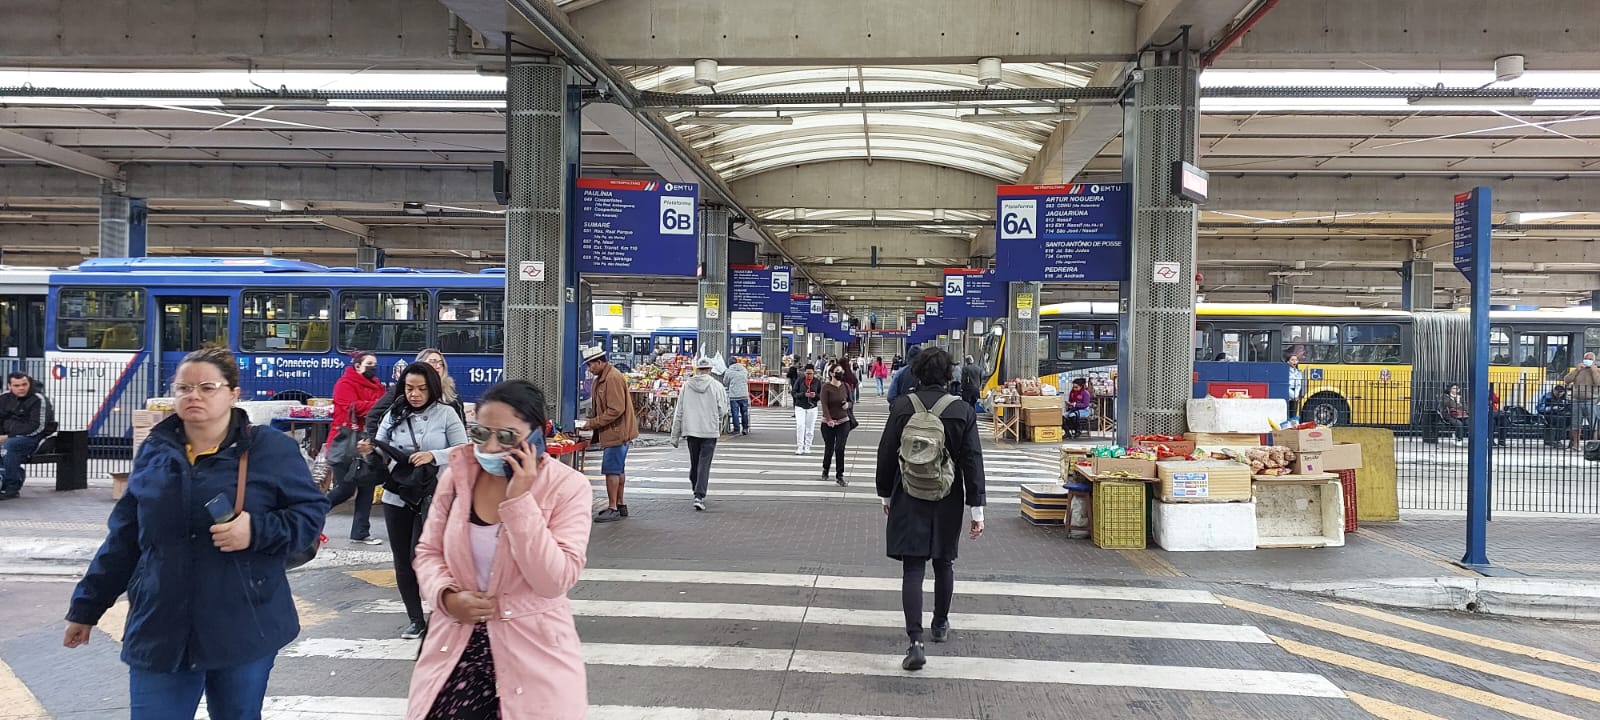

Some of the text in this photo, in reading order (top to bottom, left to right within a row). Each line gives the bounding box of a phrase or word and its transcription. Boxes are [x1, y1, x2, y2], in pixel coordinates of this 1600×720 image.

[662, 208, 691, 230] 6B
[1003, 213, 1032, 234] 6A
[773, 278, 787, 289] 5B
[948, 282, 962, 294] 5A
[276, 357, 319, 368] Consórcio
[70, 368, 105, 377] EMTU
[276, 370, 310, 378] Capellini
